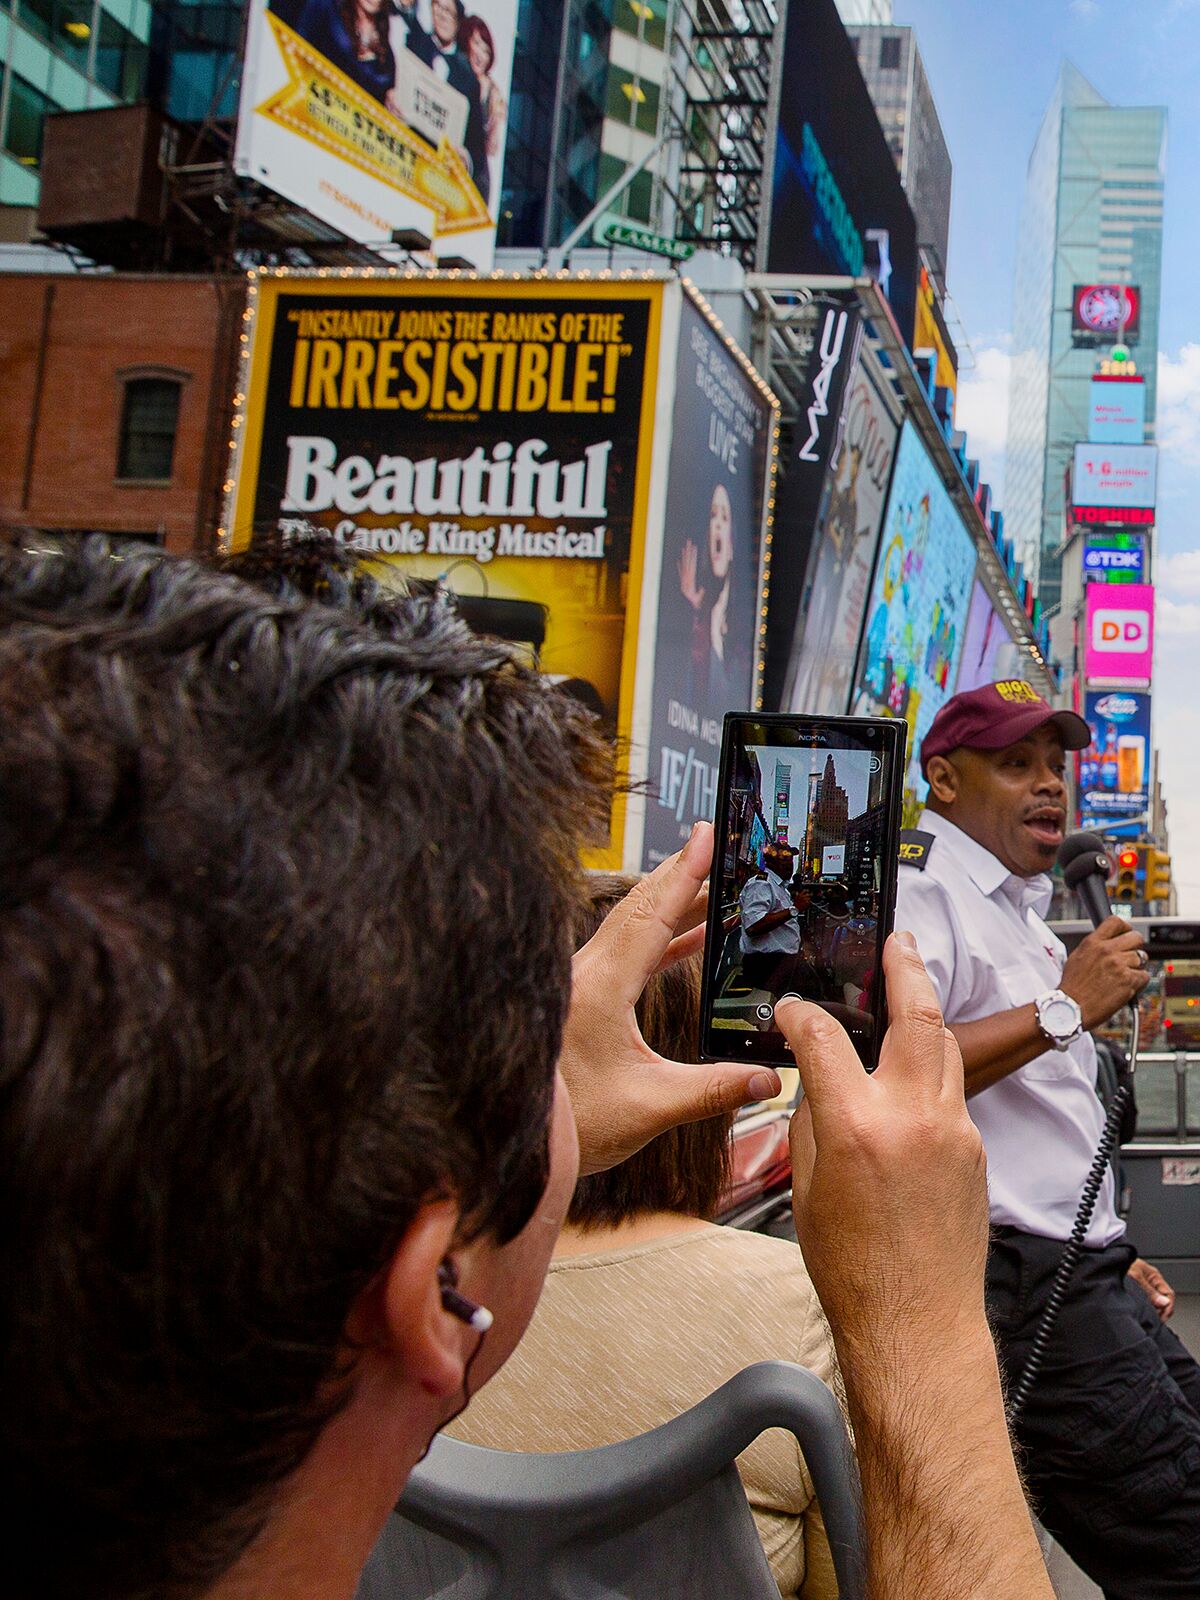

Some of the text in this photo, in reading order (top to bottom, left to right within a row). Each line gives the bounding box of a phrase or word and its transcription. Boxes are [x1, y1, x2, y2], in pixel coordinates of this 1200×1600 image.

[353, 111, 416, 165] STREET
[612, 224, 688, 257] LAMAR
[395, 311, 452, 340] JOINS
[453, 311, 490, 341] THE
[491, 312, 557, 342] RANKS
[559, 313, 587, 343] OF
[587, 313, 625, 343] THE
[708, 412, 738, 475] LIVE
[280, 436, 613, 519] Beautiful
[1074, 506, 1155, 524] TOSHIBA
[334, 519, 426, 554] Carole
[428, 520, 495, 563] King
[497, 523, 607, 558] Musical
[1099, 551, 1141, 568] TDK
[667, 699, 700, 738] IDINA
